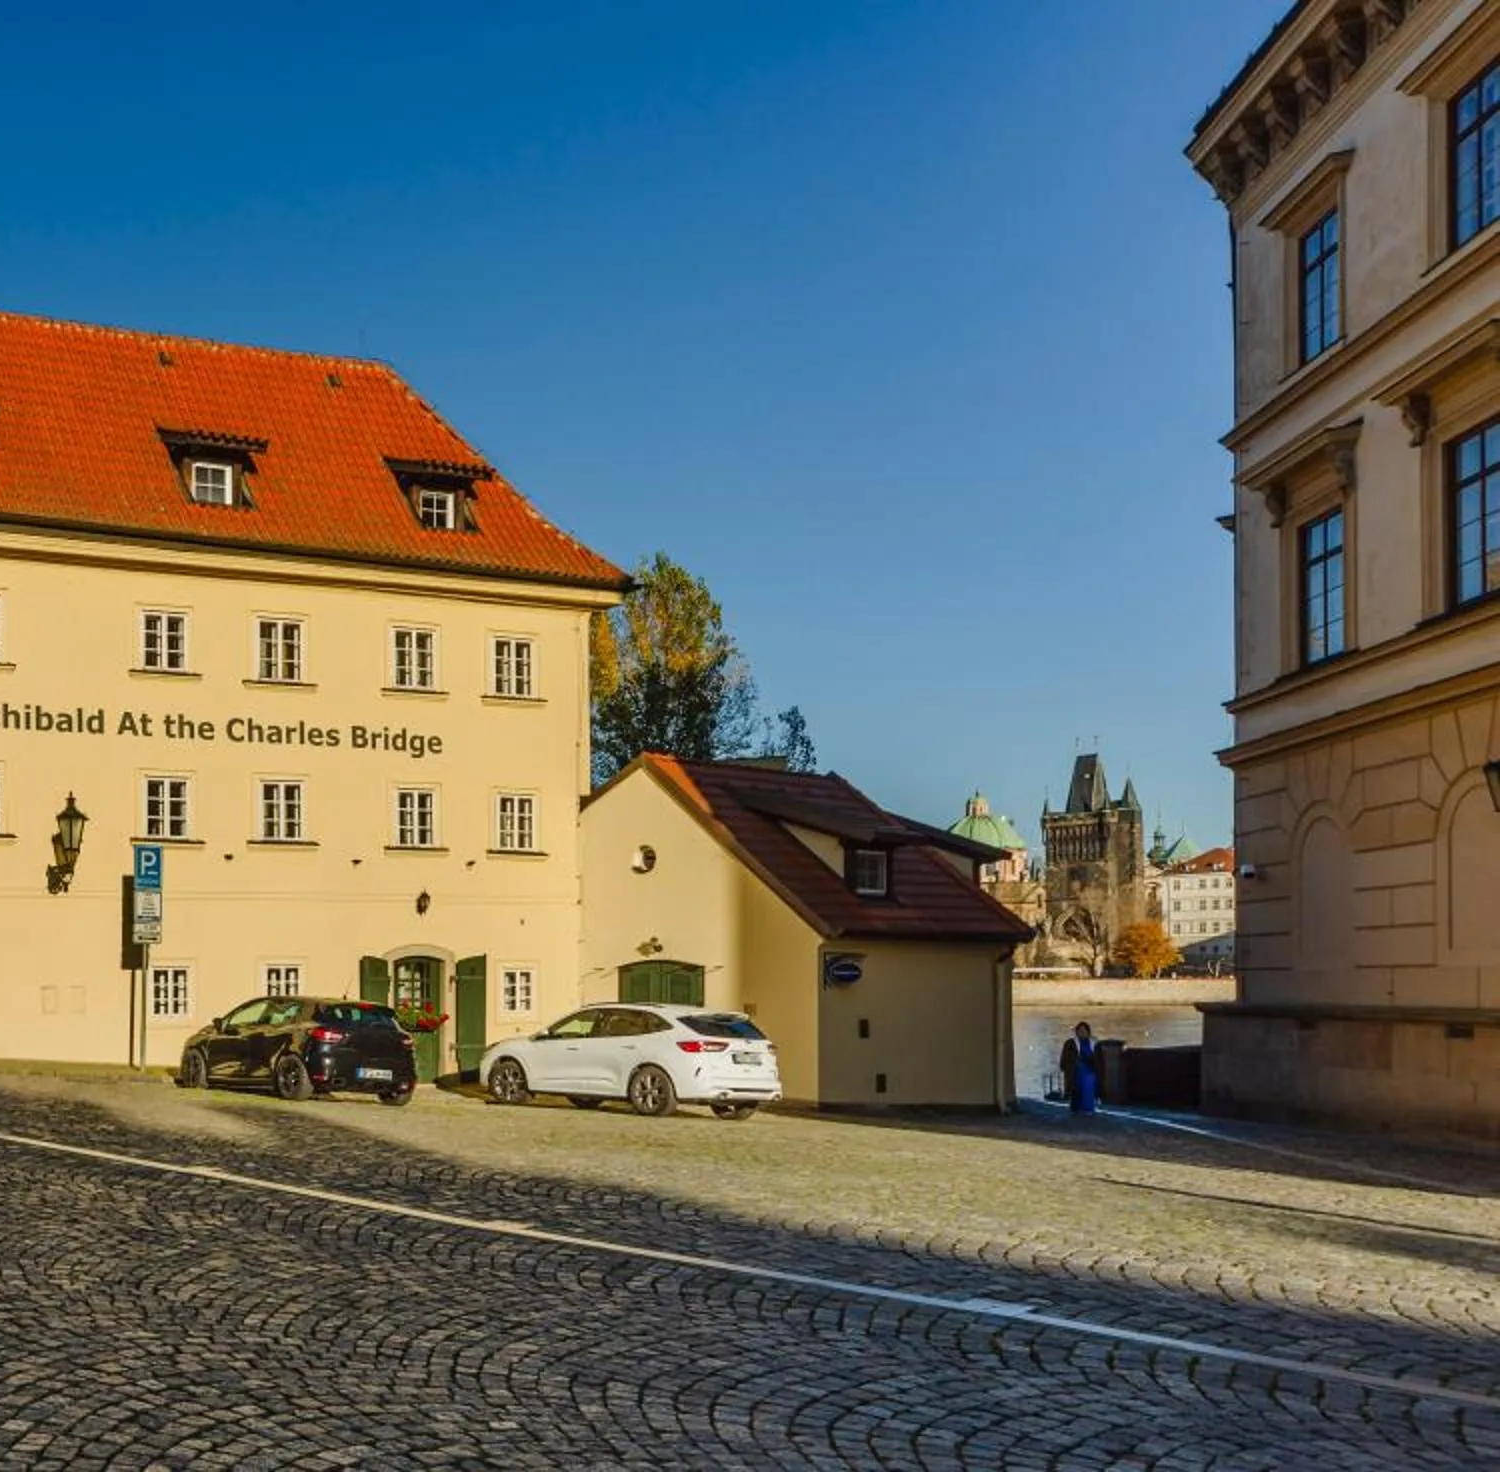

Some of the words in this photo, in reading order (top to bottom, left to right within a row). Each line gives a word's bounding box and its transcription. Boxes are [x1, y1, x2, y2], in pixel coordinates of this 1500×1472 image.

[117, 712, 153, 737] At
[164, 714, 215, 741] the
[226, 717, 341, 747] Charles
[351, 725, 443, 759] Bridge
[140, 850, 157, 875] P
